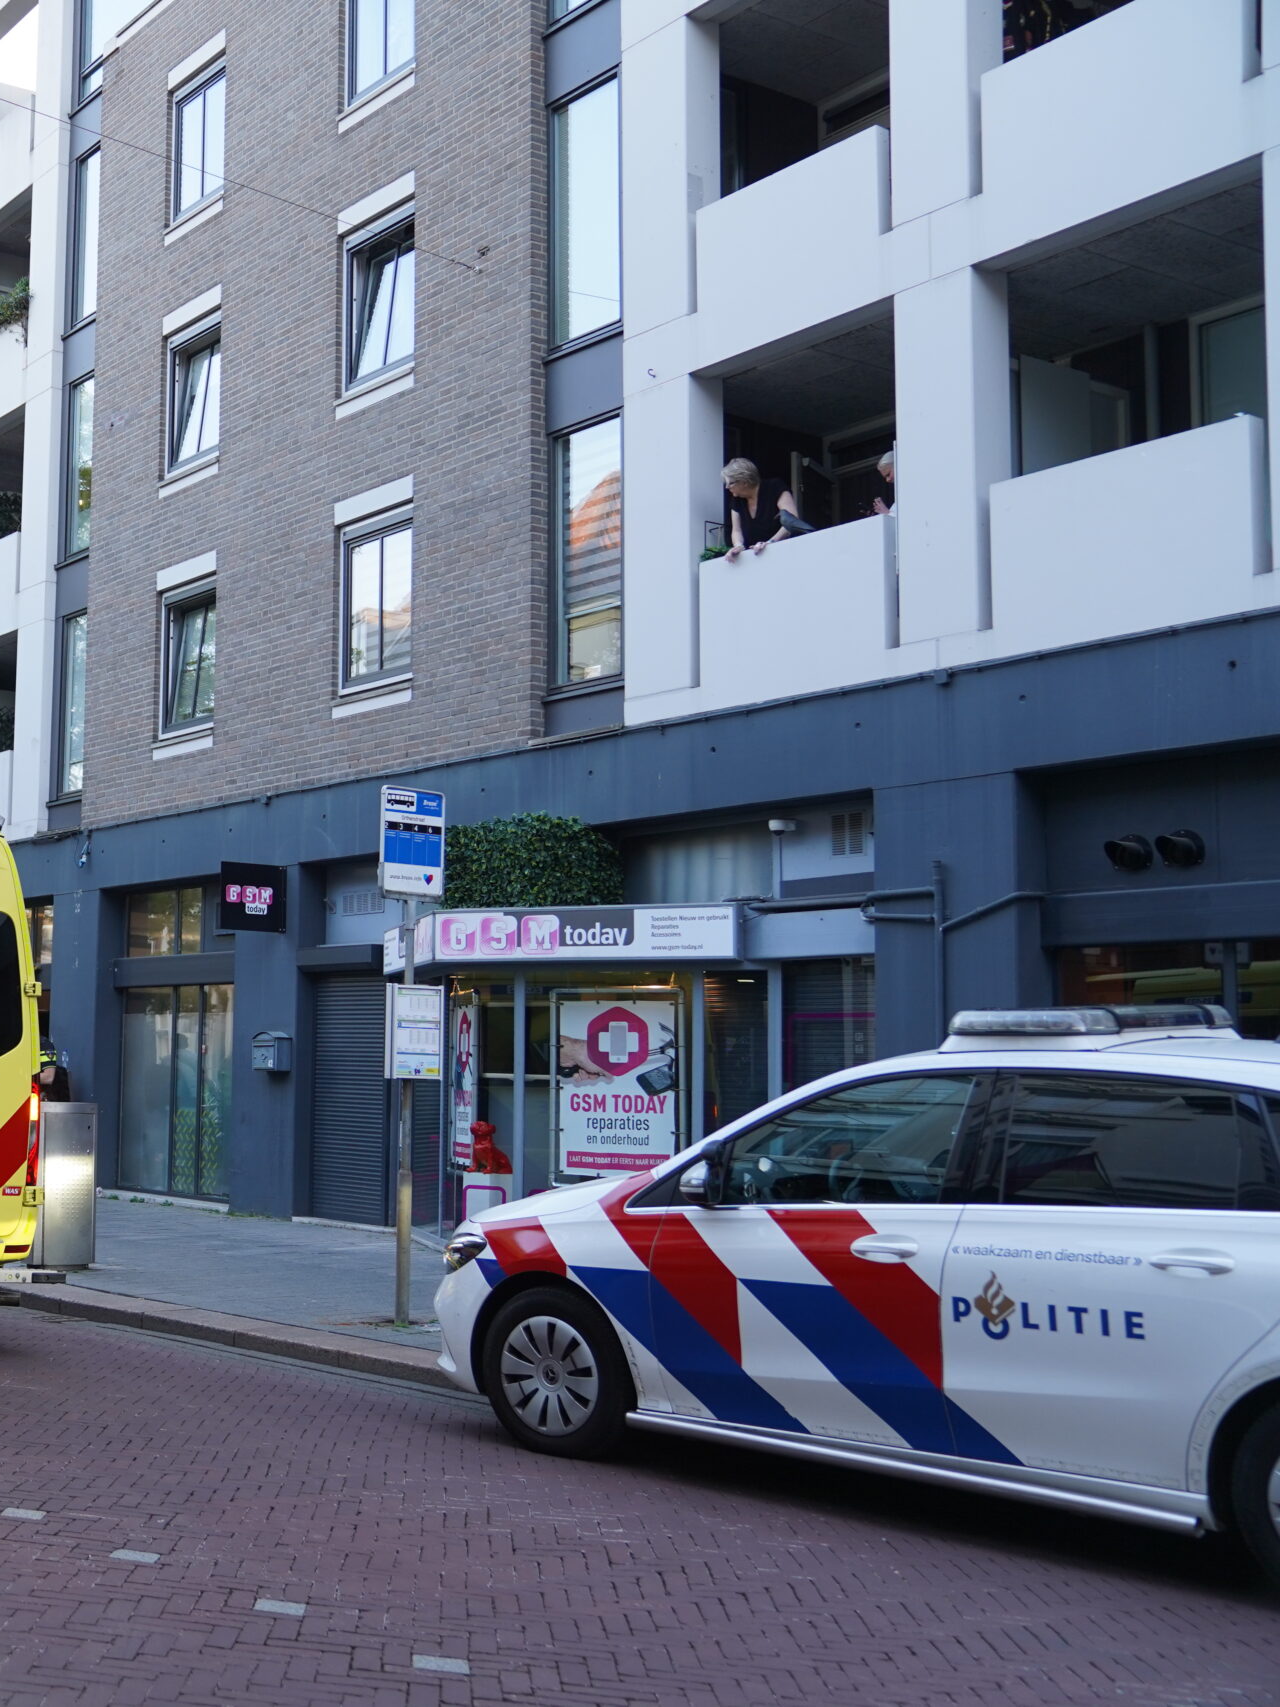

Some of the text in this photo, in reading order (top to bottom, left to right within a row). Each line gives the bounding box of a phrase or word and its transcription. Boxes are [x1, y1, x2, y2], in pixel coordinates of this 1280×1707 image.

[229, 887, 271, 903] GSM
[247, 905, 266, 914] today
[450, 919, 553, 951] GSM
[564, 922, 628, 946] today
[570, 1093, 668, 1114] GSM TODAY
[586, 1115, 650, 1133] reparaties
[586, 1133, 650, 1146] en onderhoud
[962, 1245, 1033, 1259] waakzaam
[1035, 1250, 1052, 1260] en
[1054, 1249, 1131, 1266] dienstbaar
[951, 1296, 1146, 1340] POLITIE
